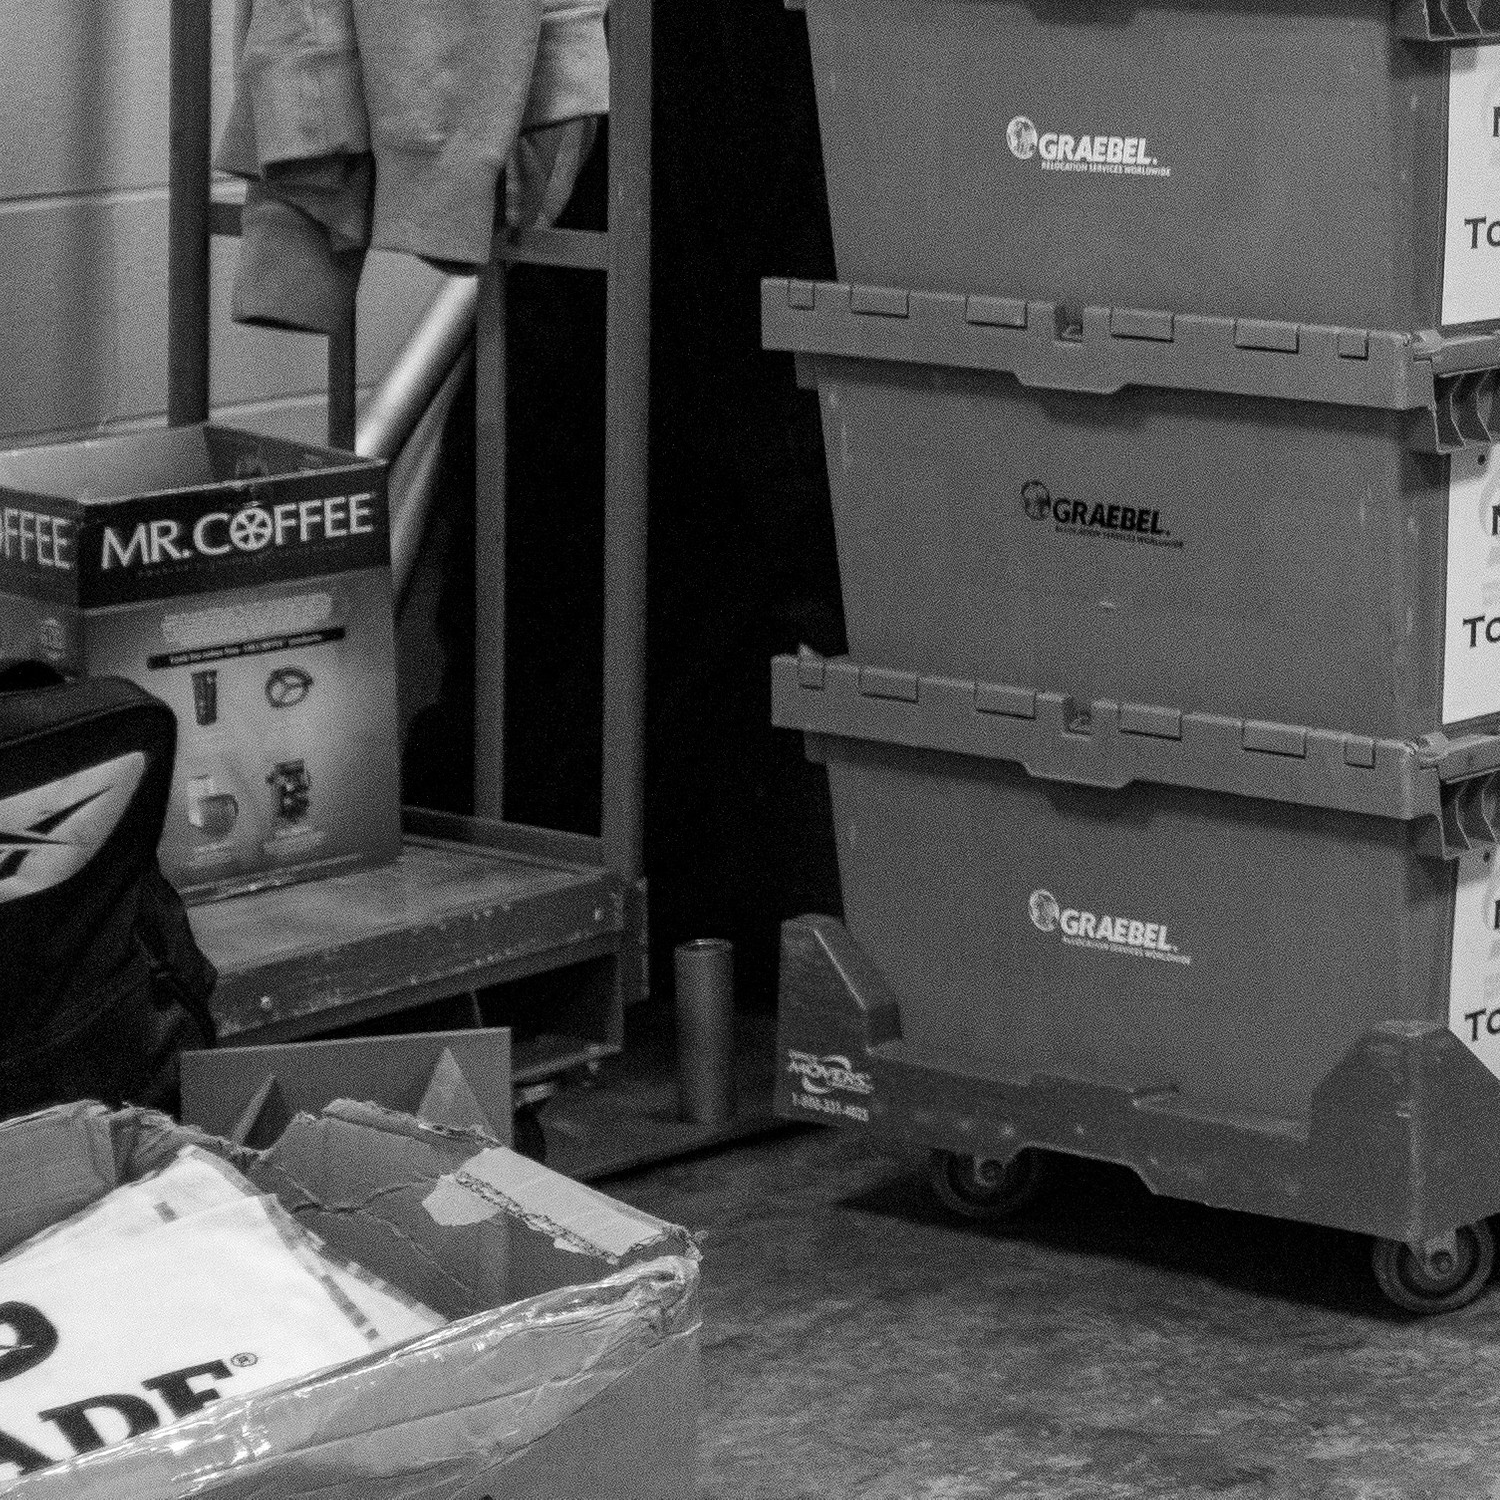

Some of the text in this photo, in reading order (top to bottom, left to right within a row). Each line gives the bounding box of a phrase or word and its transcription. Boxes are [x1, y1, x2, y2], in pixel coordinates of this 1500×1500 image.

[1042, 161, 1171, 177] RELOCATION SERVICES WORLDWIDE
[0, 507, 71, 569] FFEE
